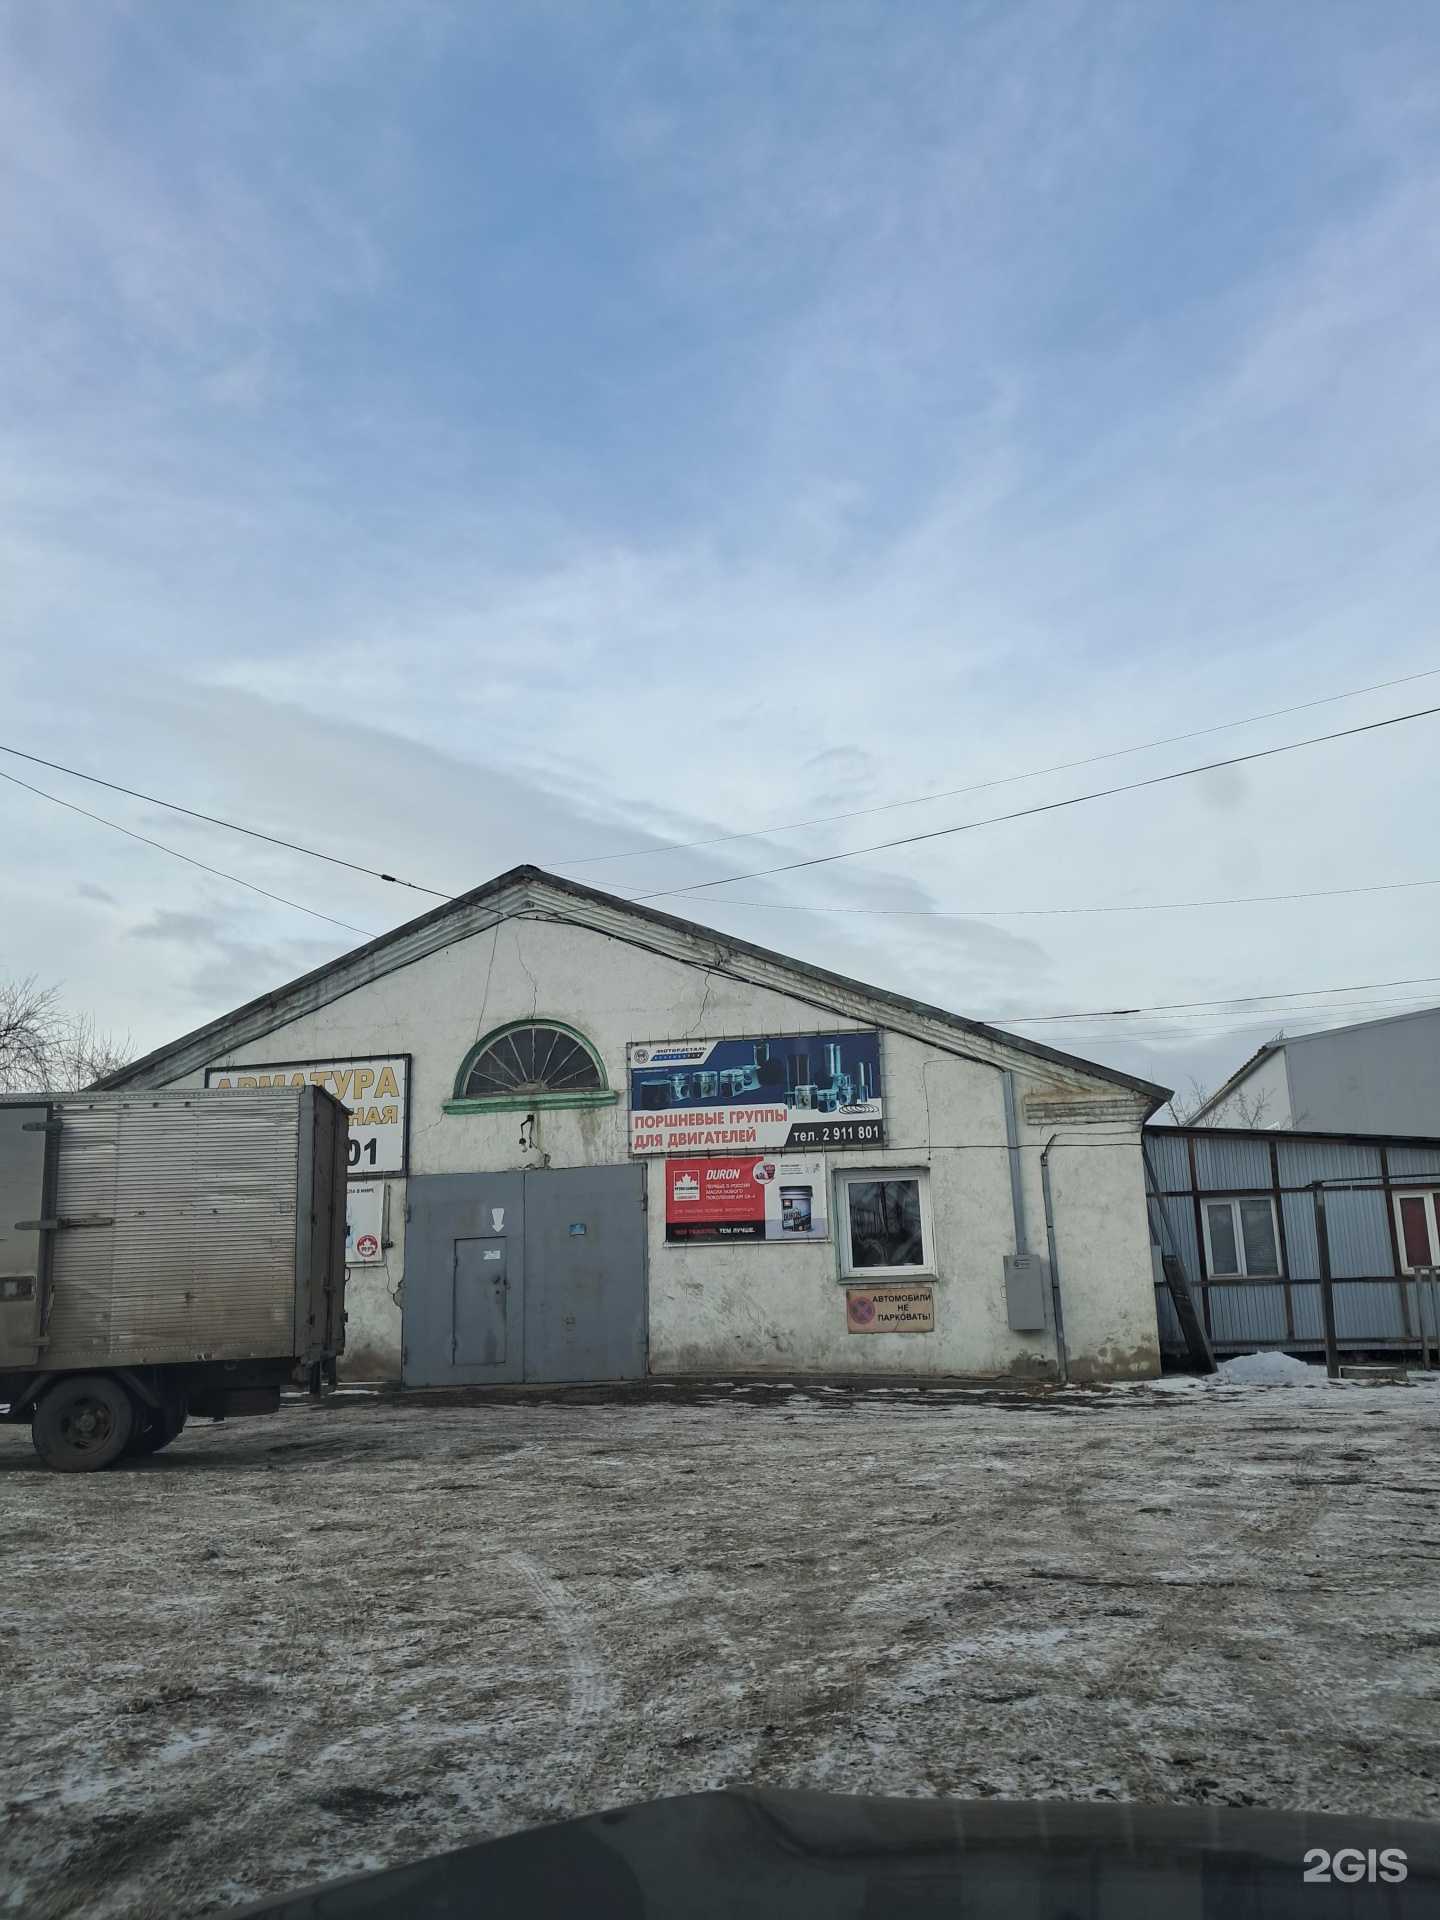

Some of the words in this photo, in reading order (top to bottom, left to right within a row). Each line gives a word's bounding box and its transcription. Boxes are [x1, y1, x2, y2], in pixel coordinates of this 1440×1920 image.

[634, 1111, 725, 1129] ПОРШНЕВЫЕ
[729, 1108, 788, 1125] ГРУППЫ
[634, 1133, 663, 1149] ДЛЯ
[667, 1127, 757, 1148] ДВИГАТЕЛЕЙ
[793, 1130, 819, 1142] тел.
[822, 1128, 830, 1141] 2
[833, 1127, 854, 1140] 911
[858, 1125, 879, 1139] 801
[706, 1168, 741, 1180] DURON
[872, 1294, 931, 1303] АВТОМОБИЛИ
[897, 1304, 910, 1312] НЕ
[878, 1314, 931, 1322] ПАРКОВАТЬ!
